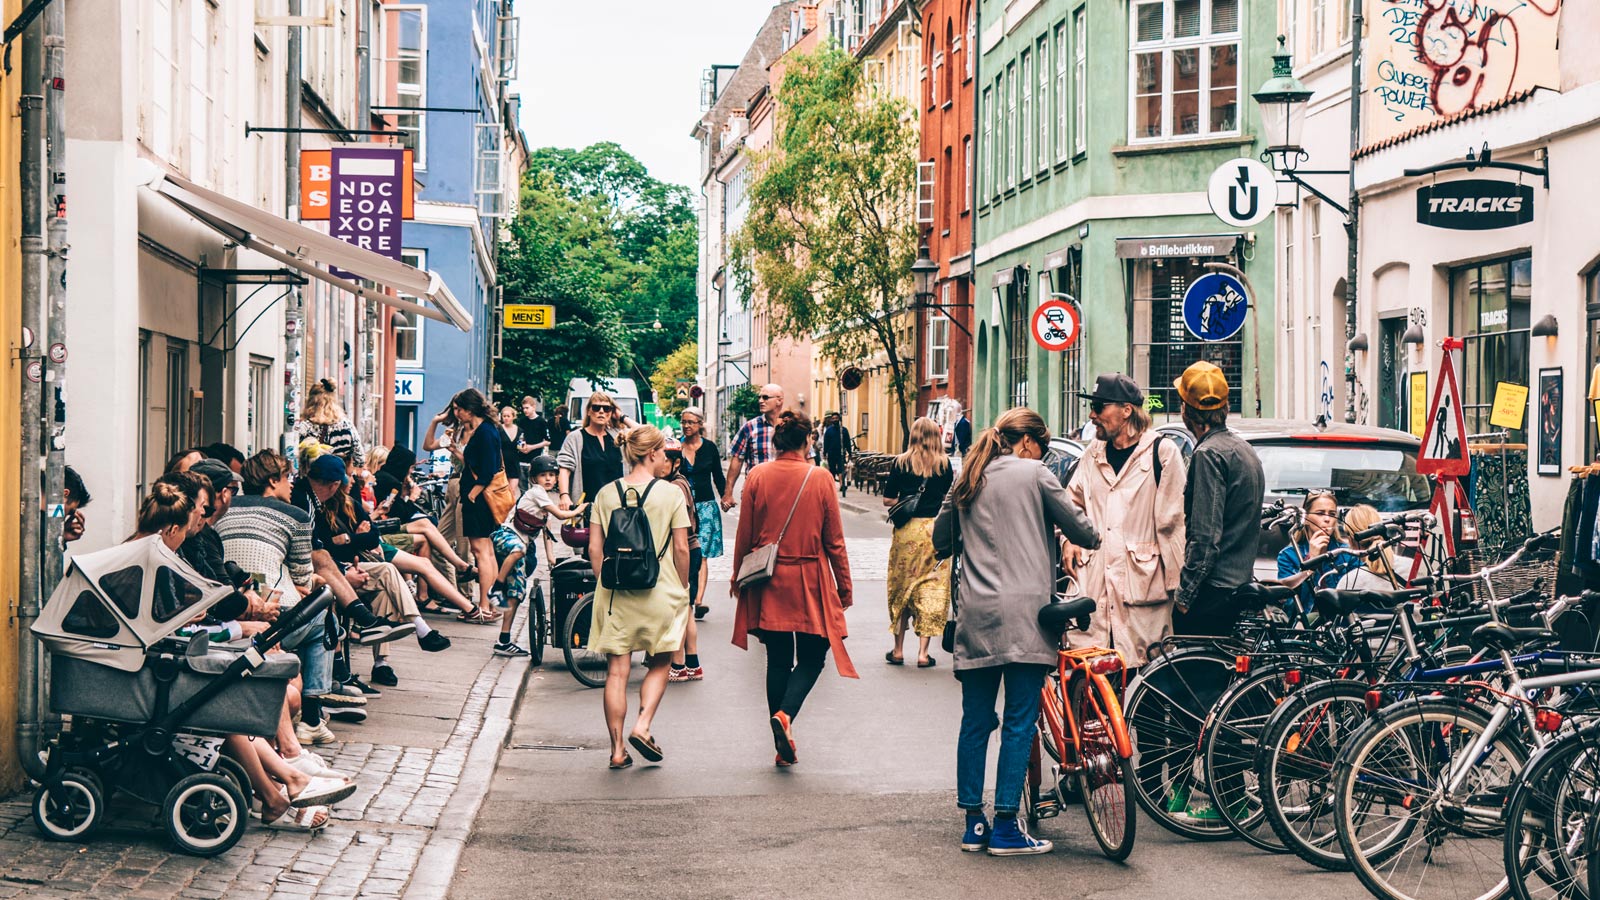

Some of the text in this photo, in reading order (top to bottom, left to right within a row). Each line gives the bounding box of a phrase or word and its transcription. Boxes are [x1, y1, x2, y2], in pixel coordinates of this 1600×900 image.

[1374, 86, 1435, 115] POWER
[1428, 197, 1523, 212] TRACKS
[1149, 244, 1215, 256] Brillebutikken
[512, 313, 541, 321] MEN'S
[1481, 309, 1508, 327] TRACKS
